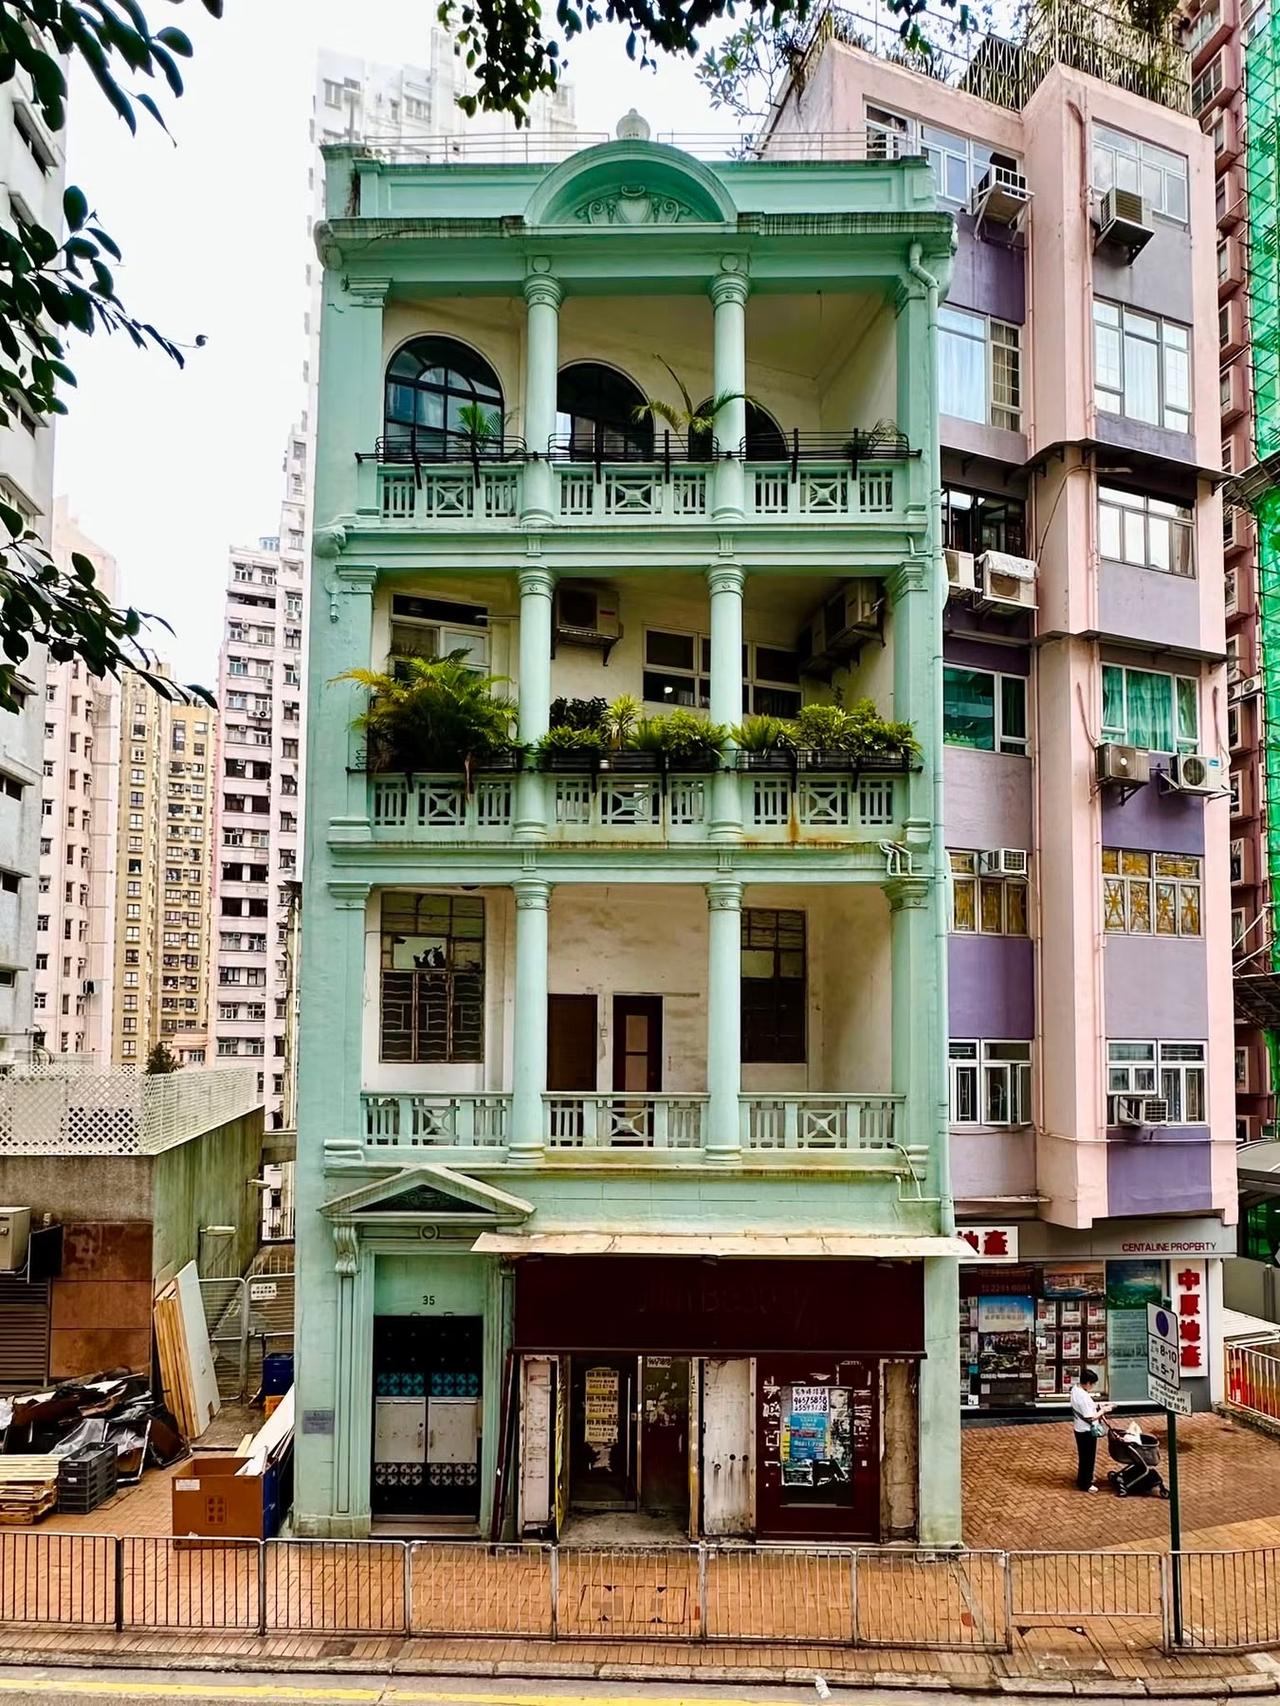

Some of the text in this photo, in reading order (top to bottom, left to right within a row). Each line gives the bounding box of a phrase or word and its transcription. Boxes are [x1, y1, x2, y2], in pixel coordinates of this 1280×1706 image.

[1122, 1241, 1217, 1252] CENTALINE PROPERTY
[422, 1295, 435, 1306] 35
[1160, 1344, 1177, 1363] 8-10
[1160, 1363, 1175, 1380] 5-7
